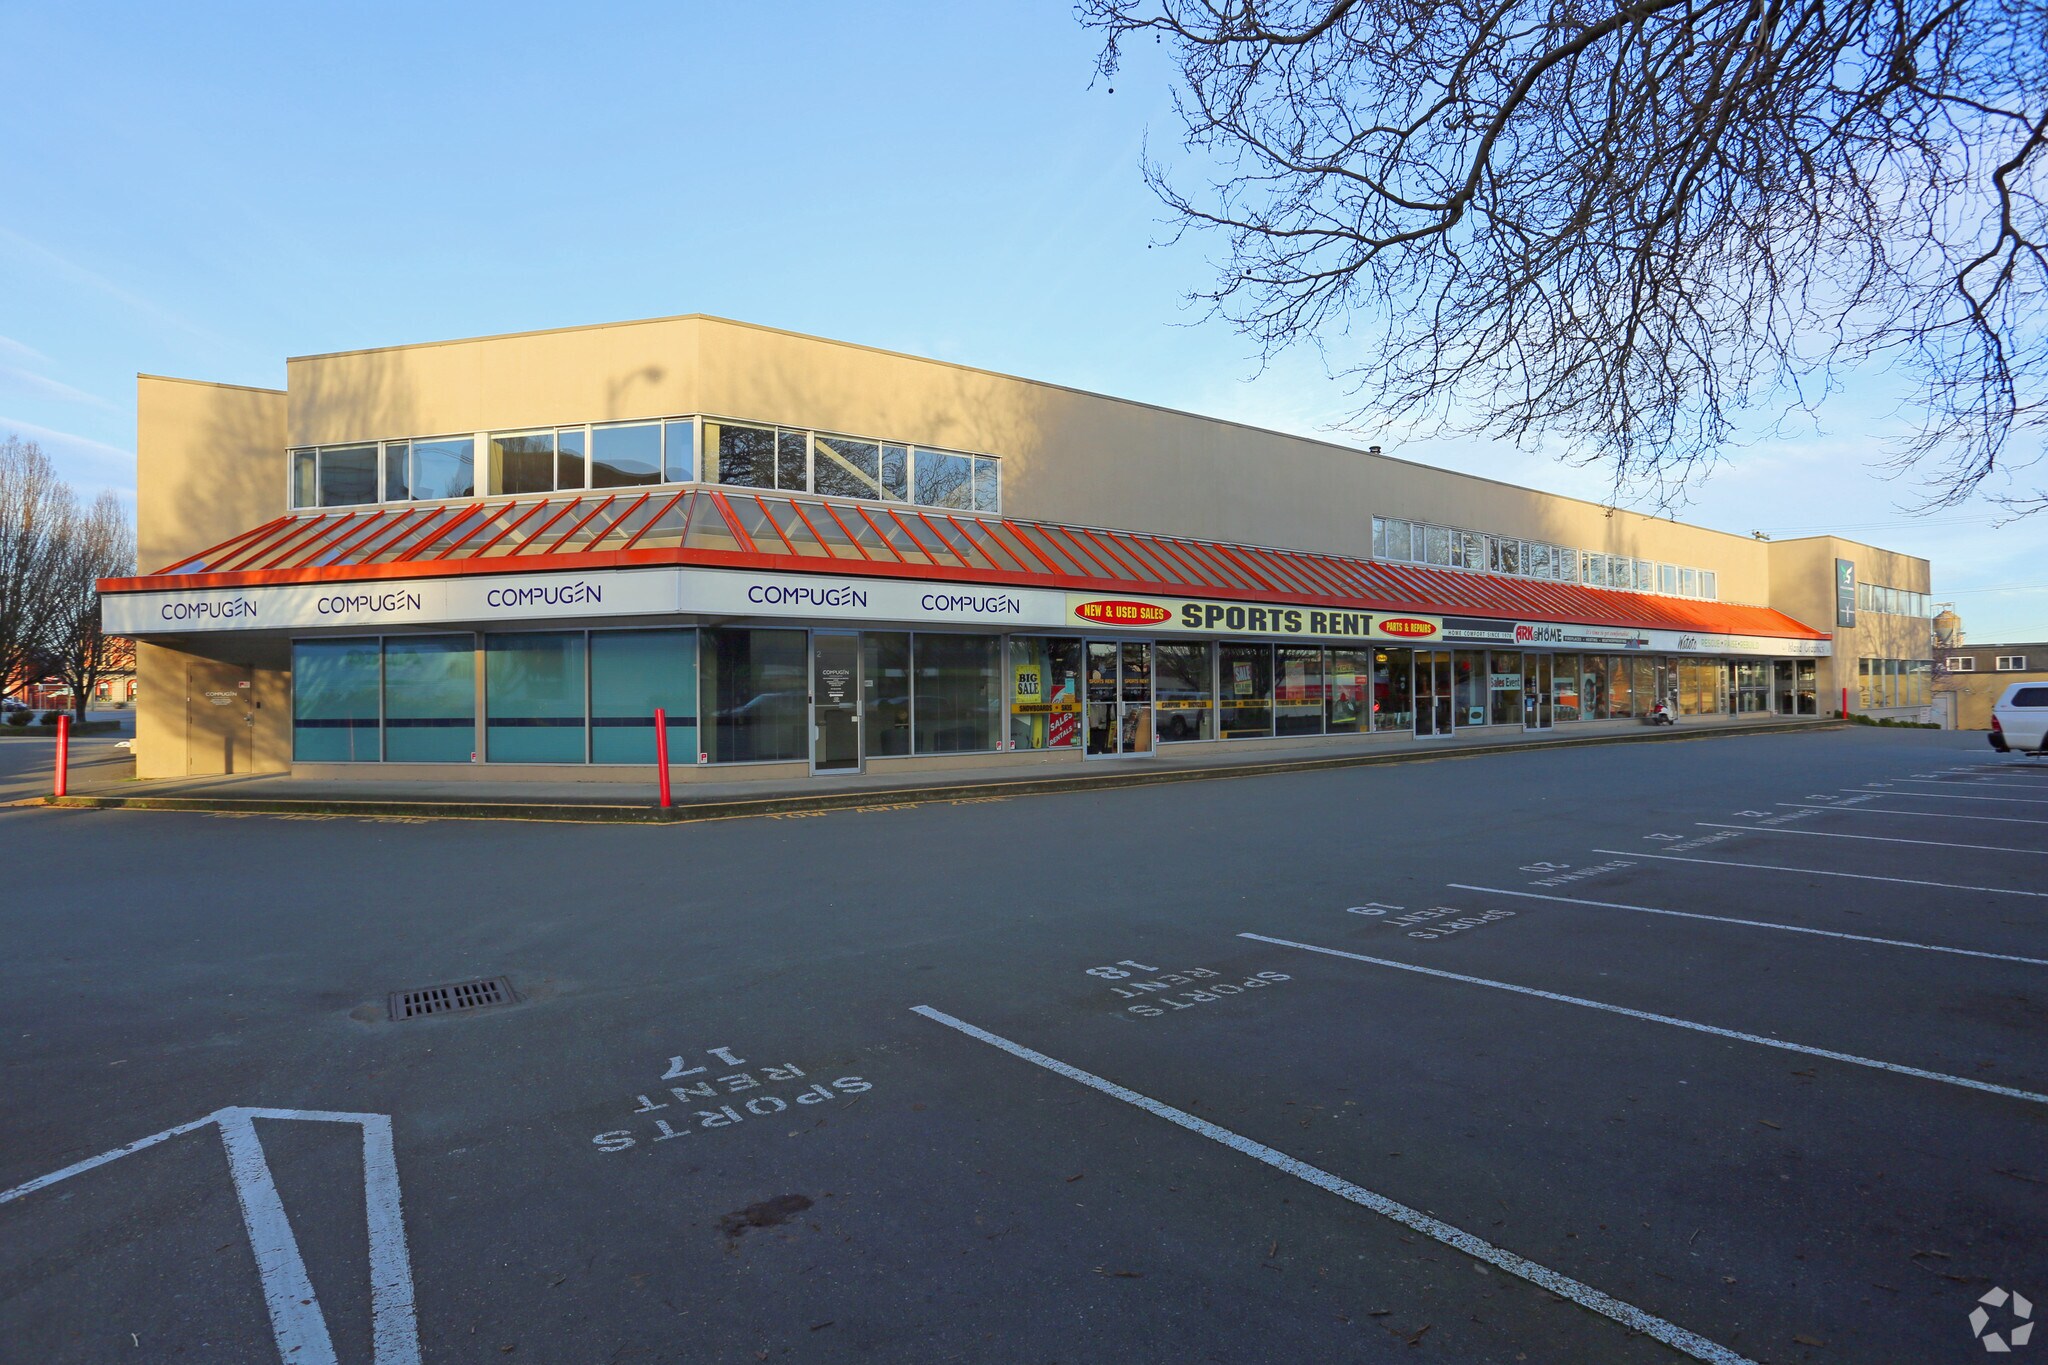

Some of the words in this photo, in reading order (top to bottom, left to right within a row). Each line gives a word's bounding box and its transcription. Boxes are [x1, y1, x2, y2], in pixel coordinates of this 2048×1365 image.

[318, 589, 421, 614] COMPUGEN
[487, 581, 601, 607] COMPUGEN
[748, 586, 867, 607] COMPUGEN
[921, 595, 1020, 614] COMPUGEN
[161, 597, 257, 620] COMPUGEN
[1084, 604, 1102, 617] NEW
[1105, 606, 1113, 618] &
[1116, 606, 1138, 619] USED
[1140, 608, 1164, 620] SALES
[1181, 603, 1302, 633] SPORTS
[1310, 611, 1373, 636] RENT
[1386, 622, 1403, 632] PARTS
[1404, 624, 1409, 632] &
[1410, 624, 1432, 634] REPAIRS
[817, 650, 822, 658] 2
[1018, 673, 1038, 682] BIG
[1506, 677, 1520, 688] Event
[1017, 683, 1039, 695] SALE
[1019, 704, 1053, 712] SNOWBOARDS
[1050, 712, 1073, 731] SALES
[1049, 725, 1073, 746] RENTALS
[1346, 902, 1405, 916] 19
[1383, 906, 1461, 927] RENT
[1408, 909, 1516, 939] SPORTS
[1085, 959, 1159, 980] 18
[1110, 967, 1221, 998] RENT
[1128, 971, 1294, 1017] SPORTS
[660, 1046, 746, 1080] 17
[633, 1063, 806, 1114] RENT
[592, 1076, 873, 1153] SPORTS
